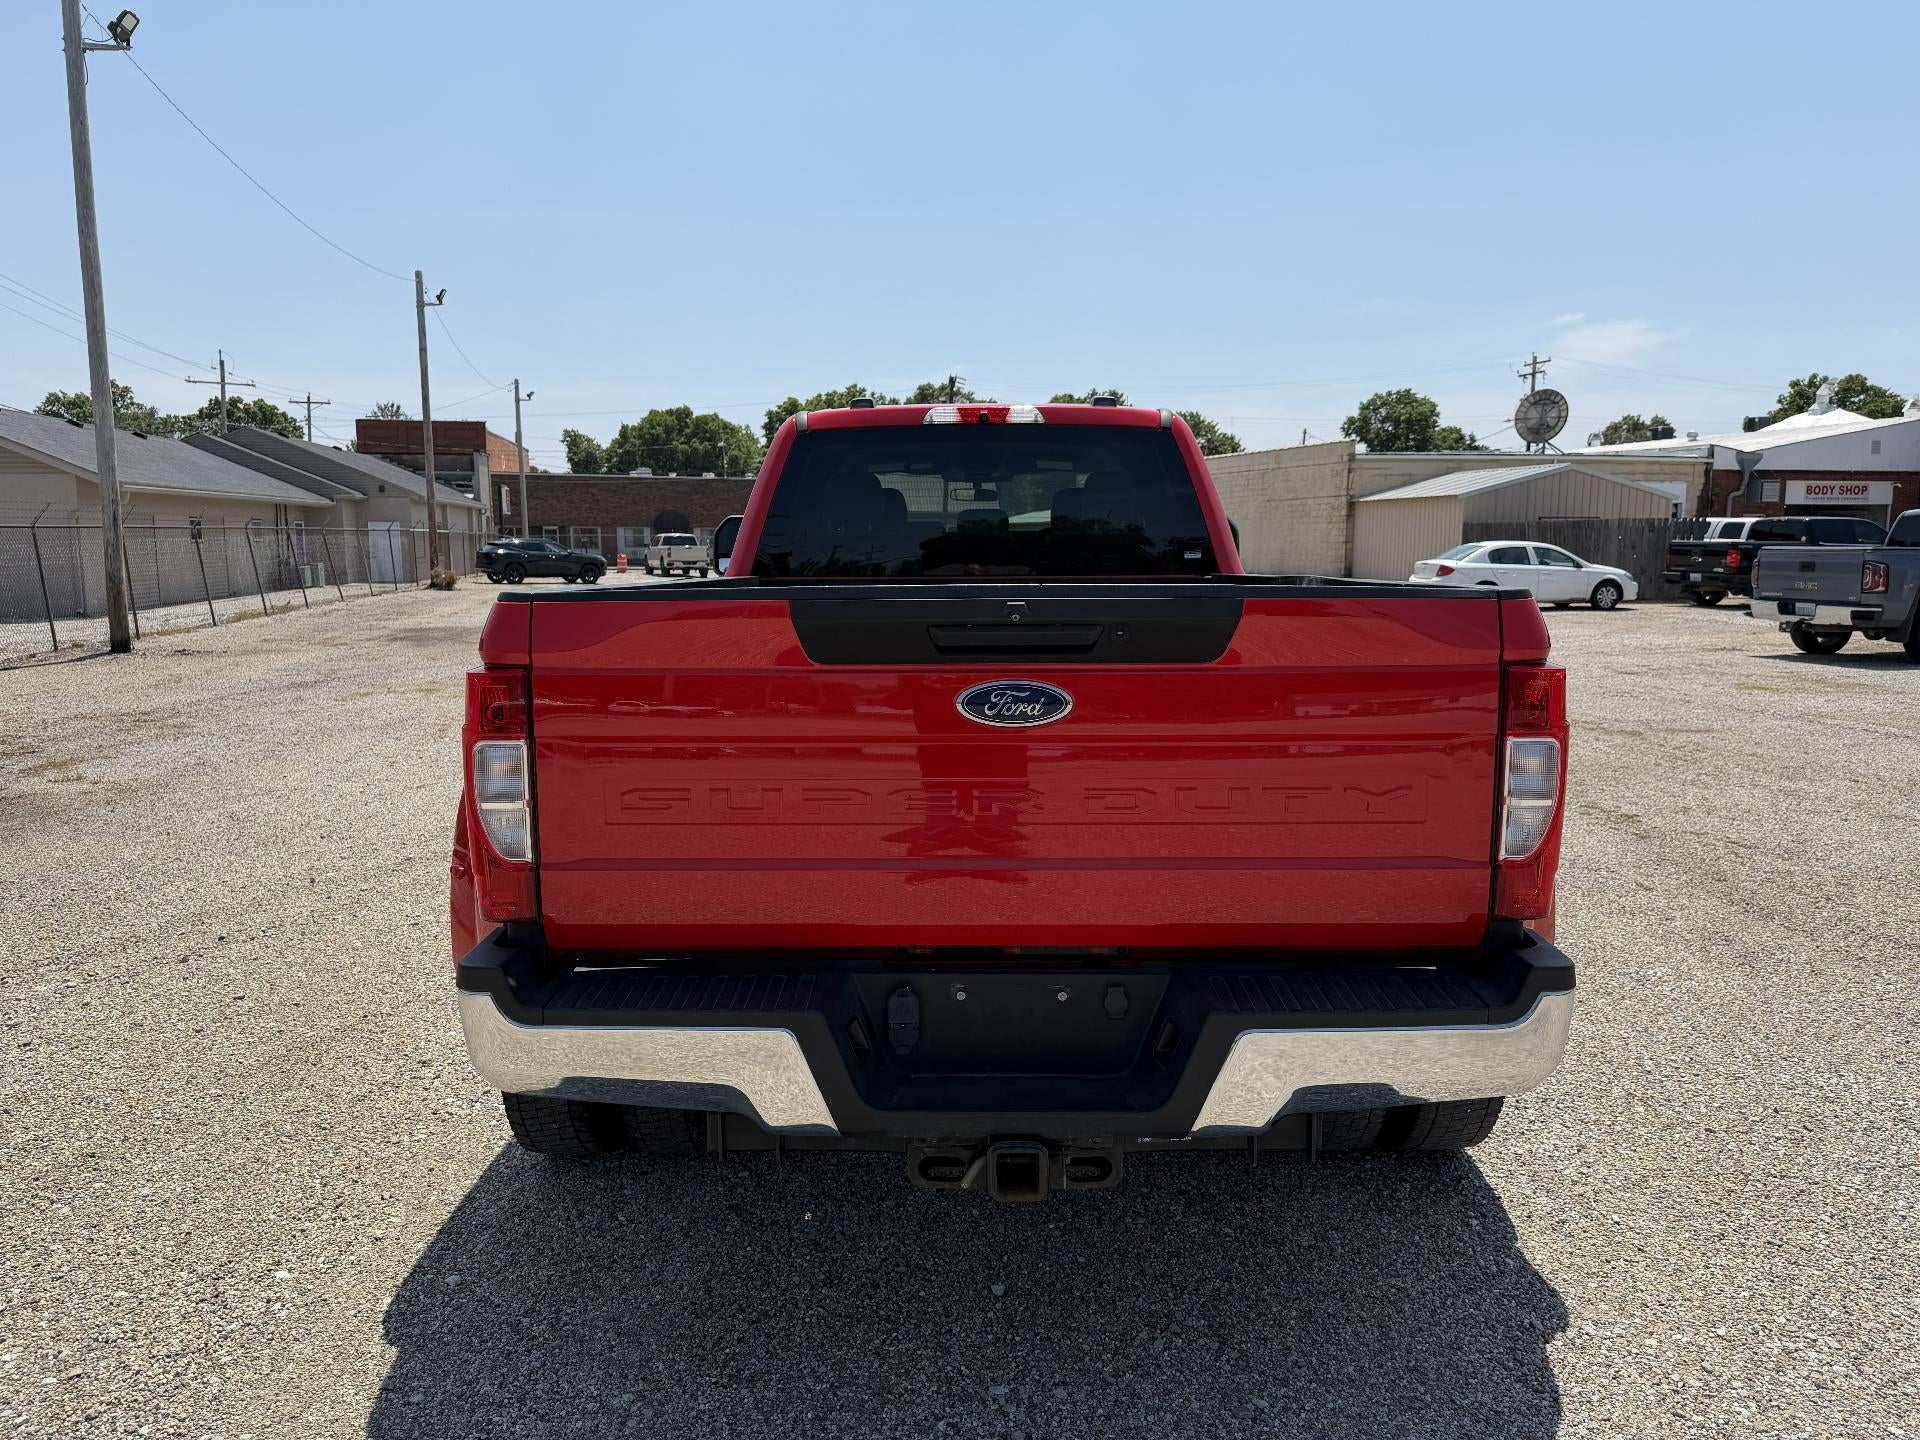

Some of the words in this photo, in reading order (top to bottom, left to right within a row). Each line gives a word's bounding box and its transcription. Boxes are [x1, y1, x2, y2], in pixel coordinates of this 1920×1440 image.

[1806, 485, 1836, 496] BODY
[1838, 485, 1868, 496] SHOP
[984, 690, 1046, 716] Ford
[619, 786, 1046, 816] SUPER
[1084, 785, 1413, 815] DUTY
